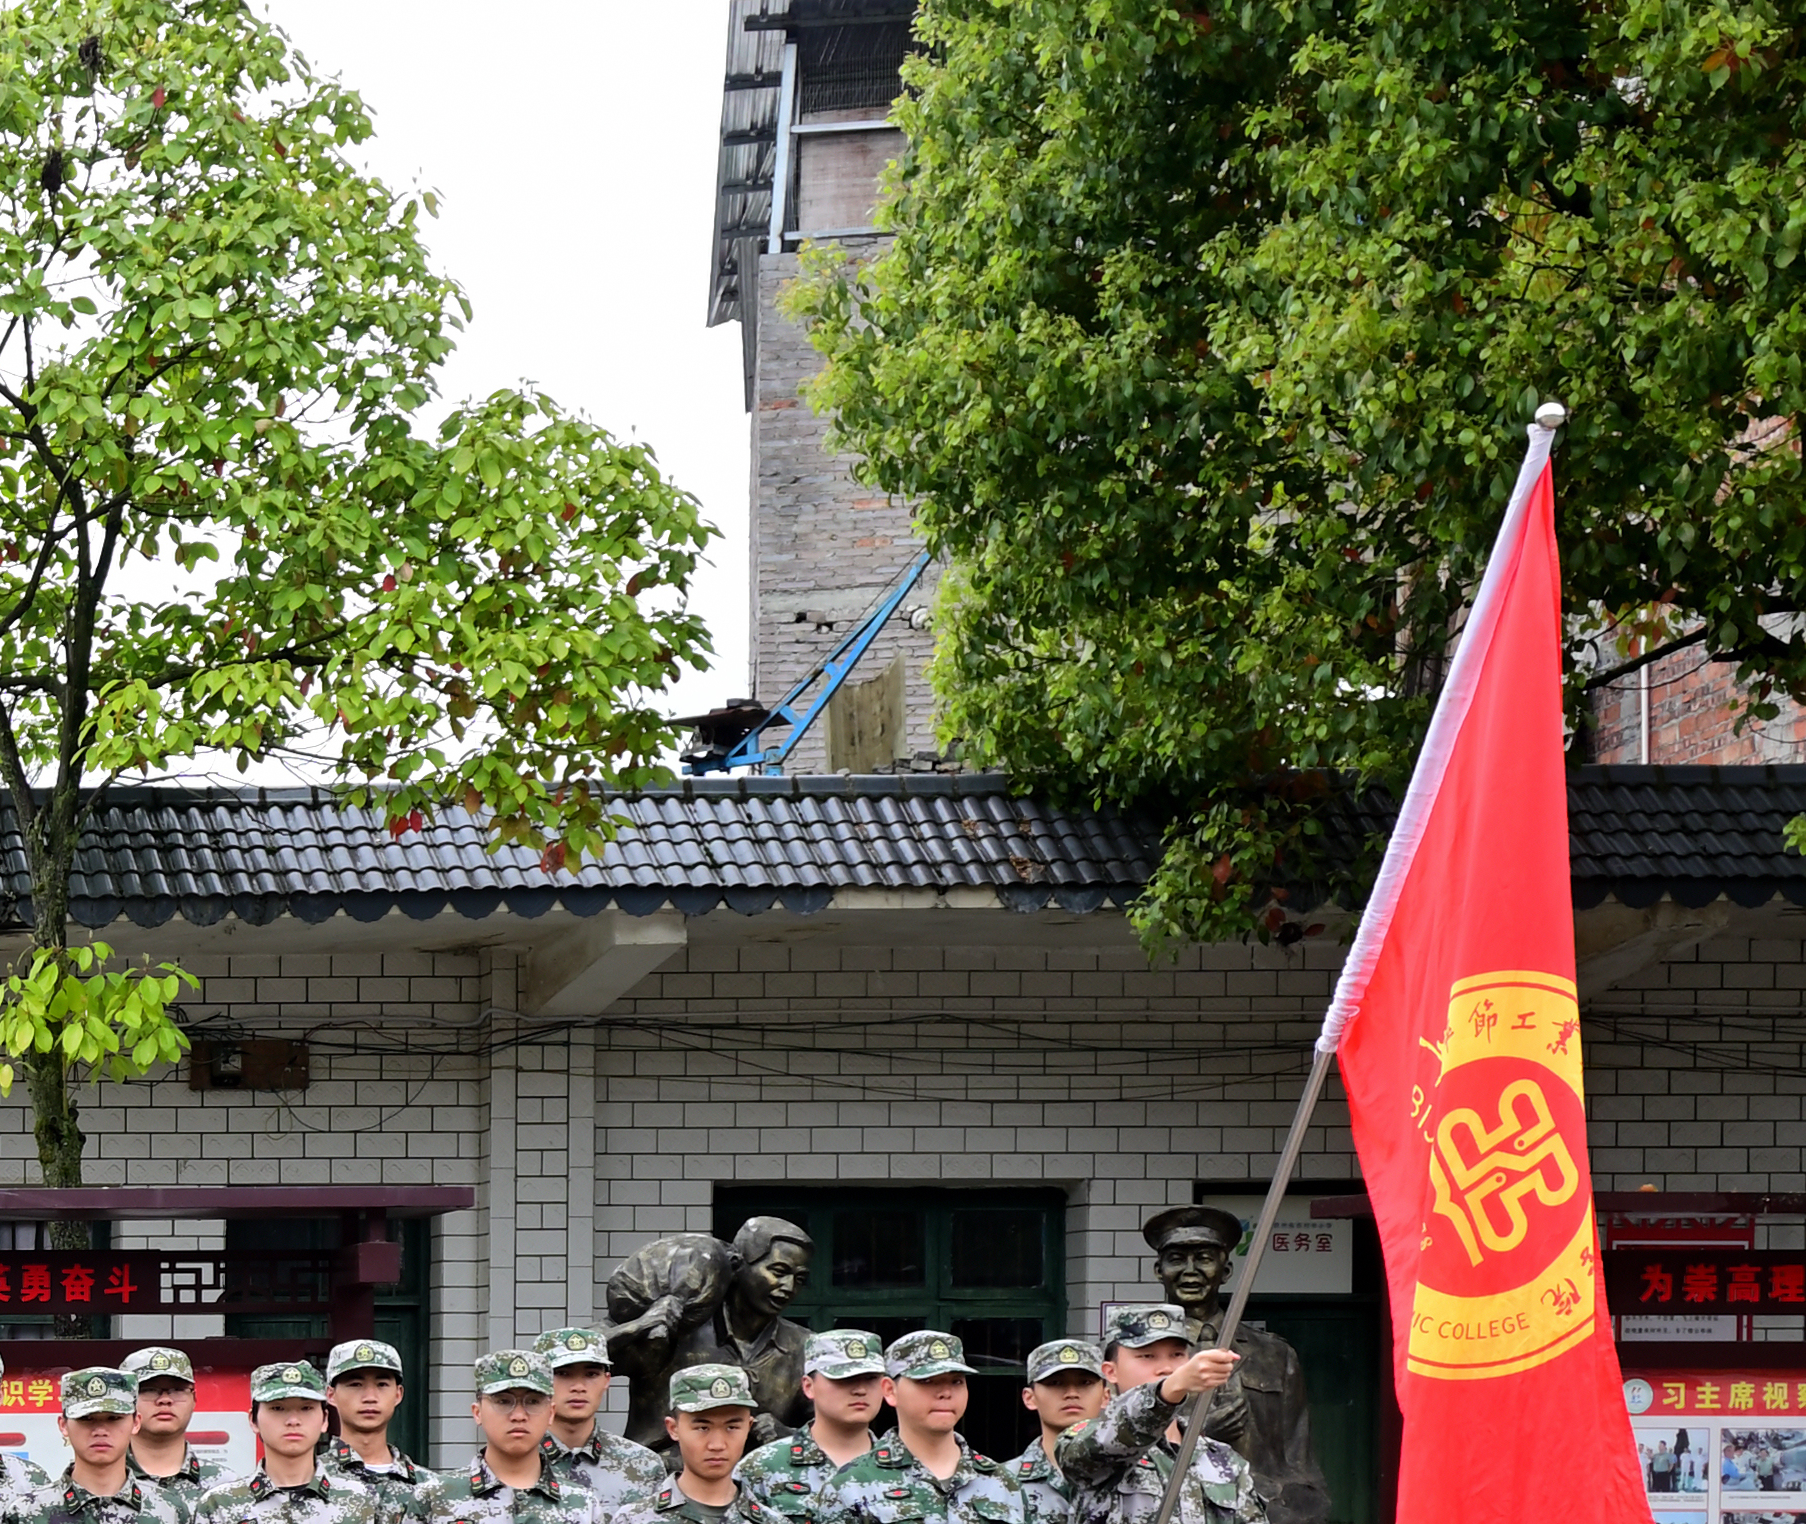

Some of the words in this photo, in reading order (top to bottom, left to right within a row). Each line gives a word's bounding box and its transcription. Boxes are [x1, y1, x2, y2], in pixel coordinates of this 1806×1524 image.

[1273, 1233, 1333, 1252] 医务室
[1639, 1263, 1806, 1303] 为崇高理
[1438, 1312, 1530, 1340] COLLEGE
[0, 1379, 62, 1407] 识学
